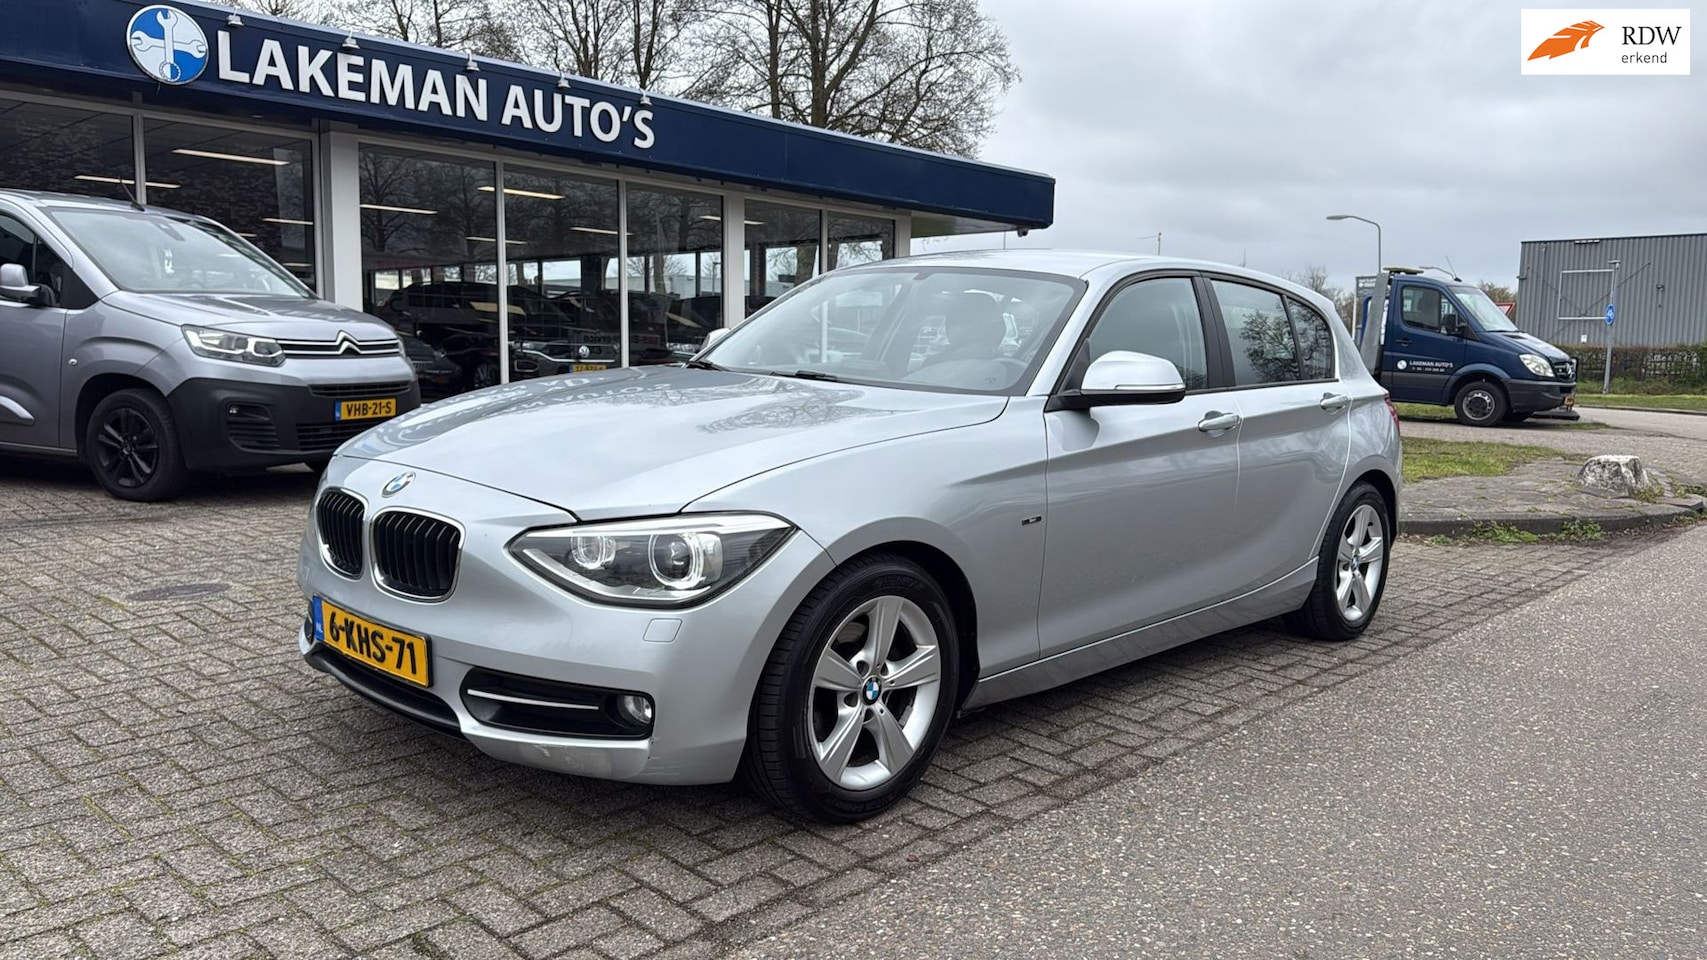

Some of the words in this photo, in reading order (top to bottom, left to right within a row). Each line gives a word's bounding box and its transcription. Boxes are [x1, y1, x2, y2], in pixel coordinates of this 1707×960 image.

[217, 30, 488, 122] LAKEMAN
[501, 84, 655, 150] AUTO'S
[346, 400, 392, 417] VHB-21-S
[329, 611, 417, 675] 6-KHS-71
